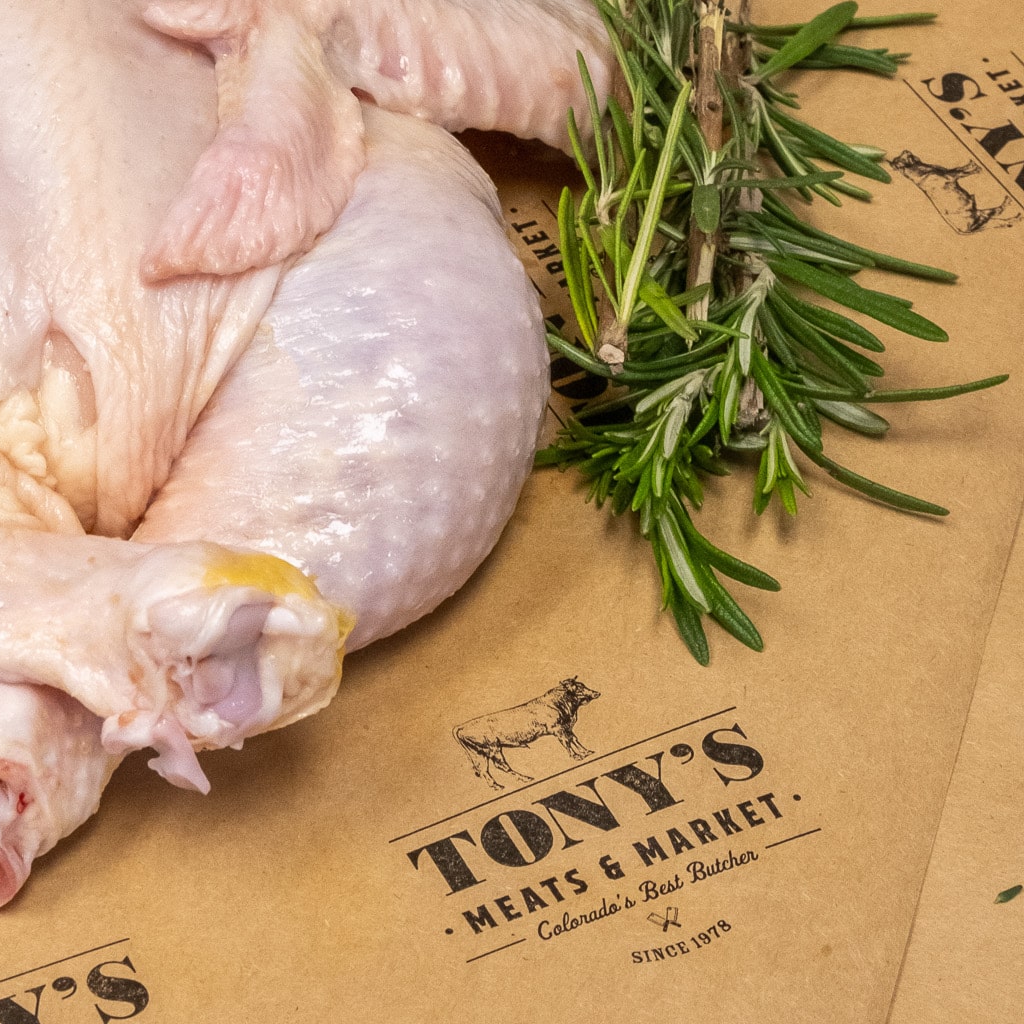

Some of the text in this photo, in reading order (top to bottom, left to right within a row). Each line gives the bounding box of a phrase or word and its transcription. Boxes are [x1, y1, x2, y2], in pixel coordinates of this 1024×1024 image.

[407, 723, 764, 897] TONY'S
[461, 792, 784, 935] MEATS & MARKET
[537, 847, 759, 942] Colorado's Best Butcher
[631, 918, 733, 965] SINCE 1978
